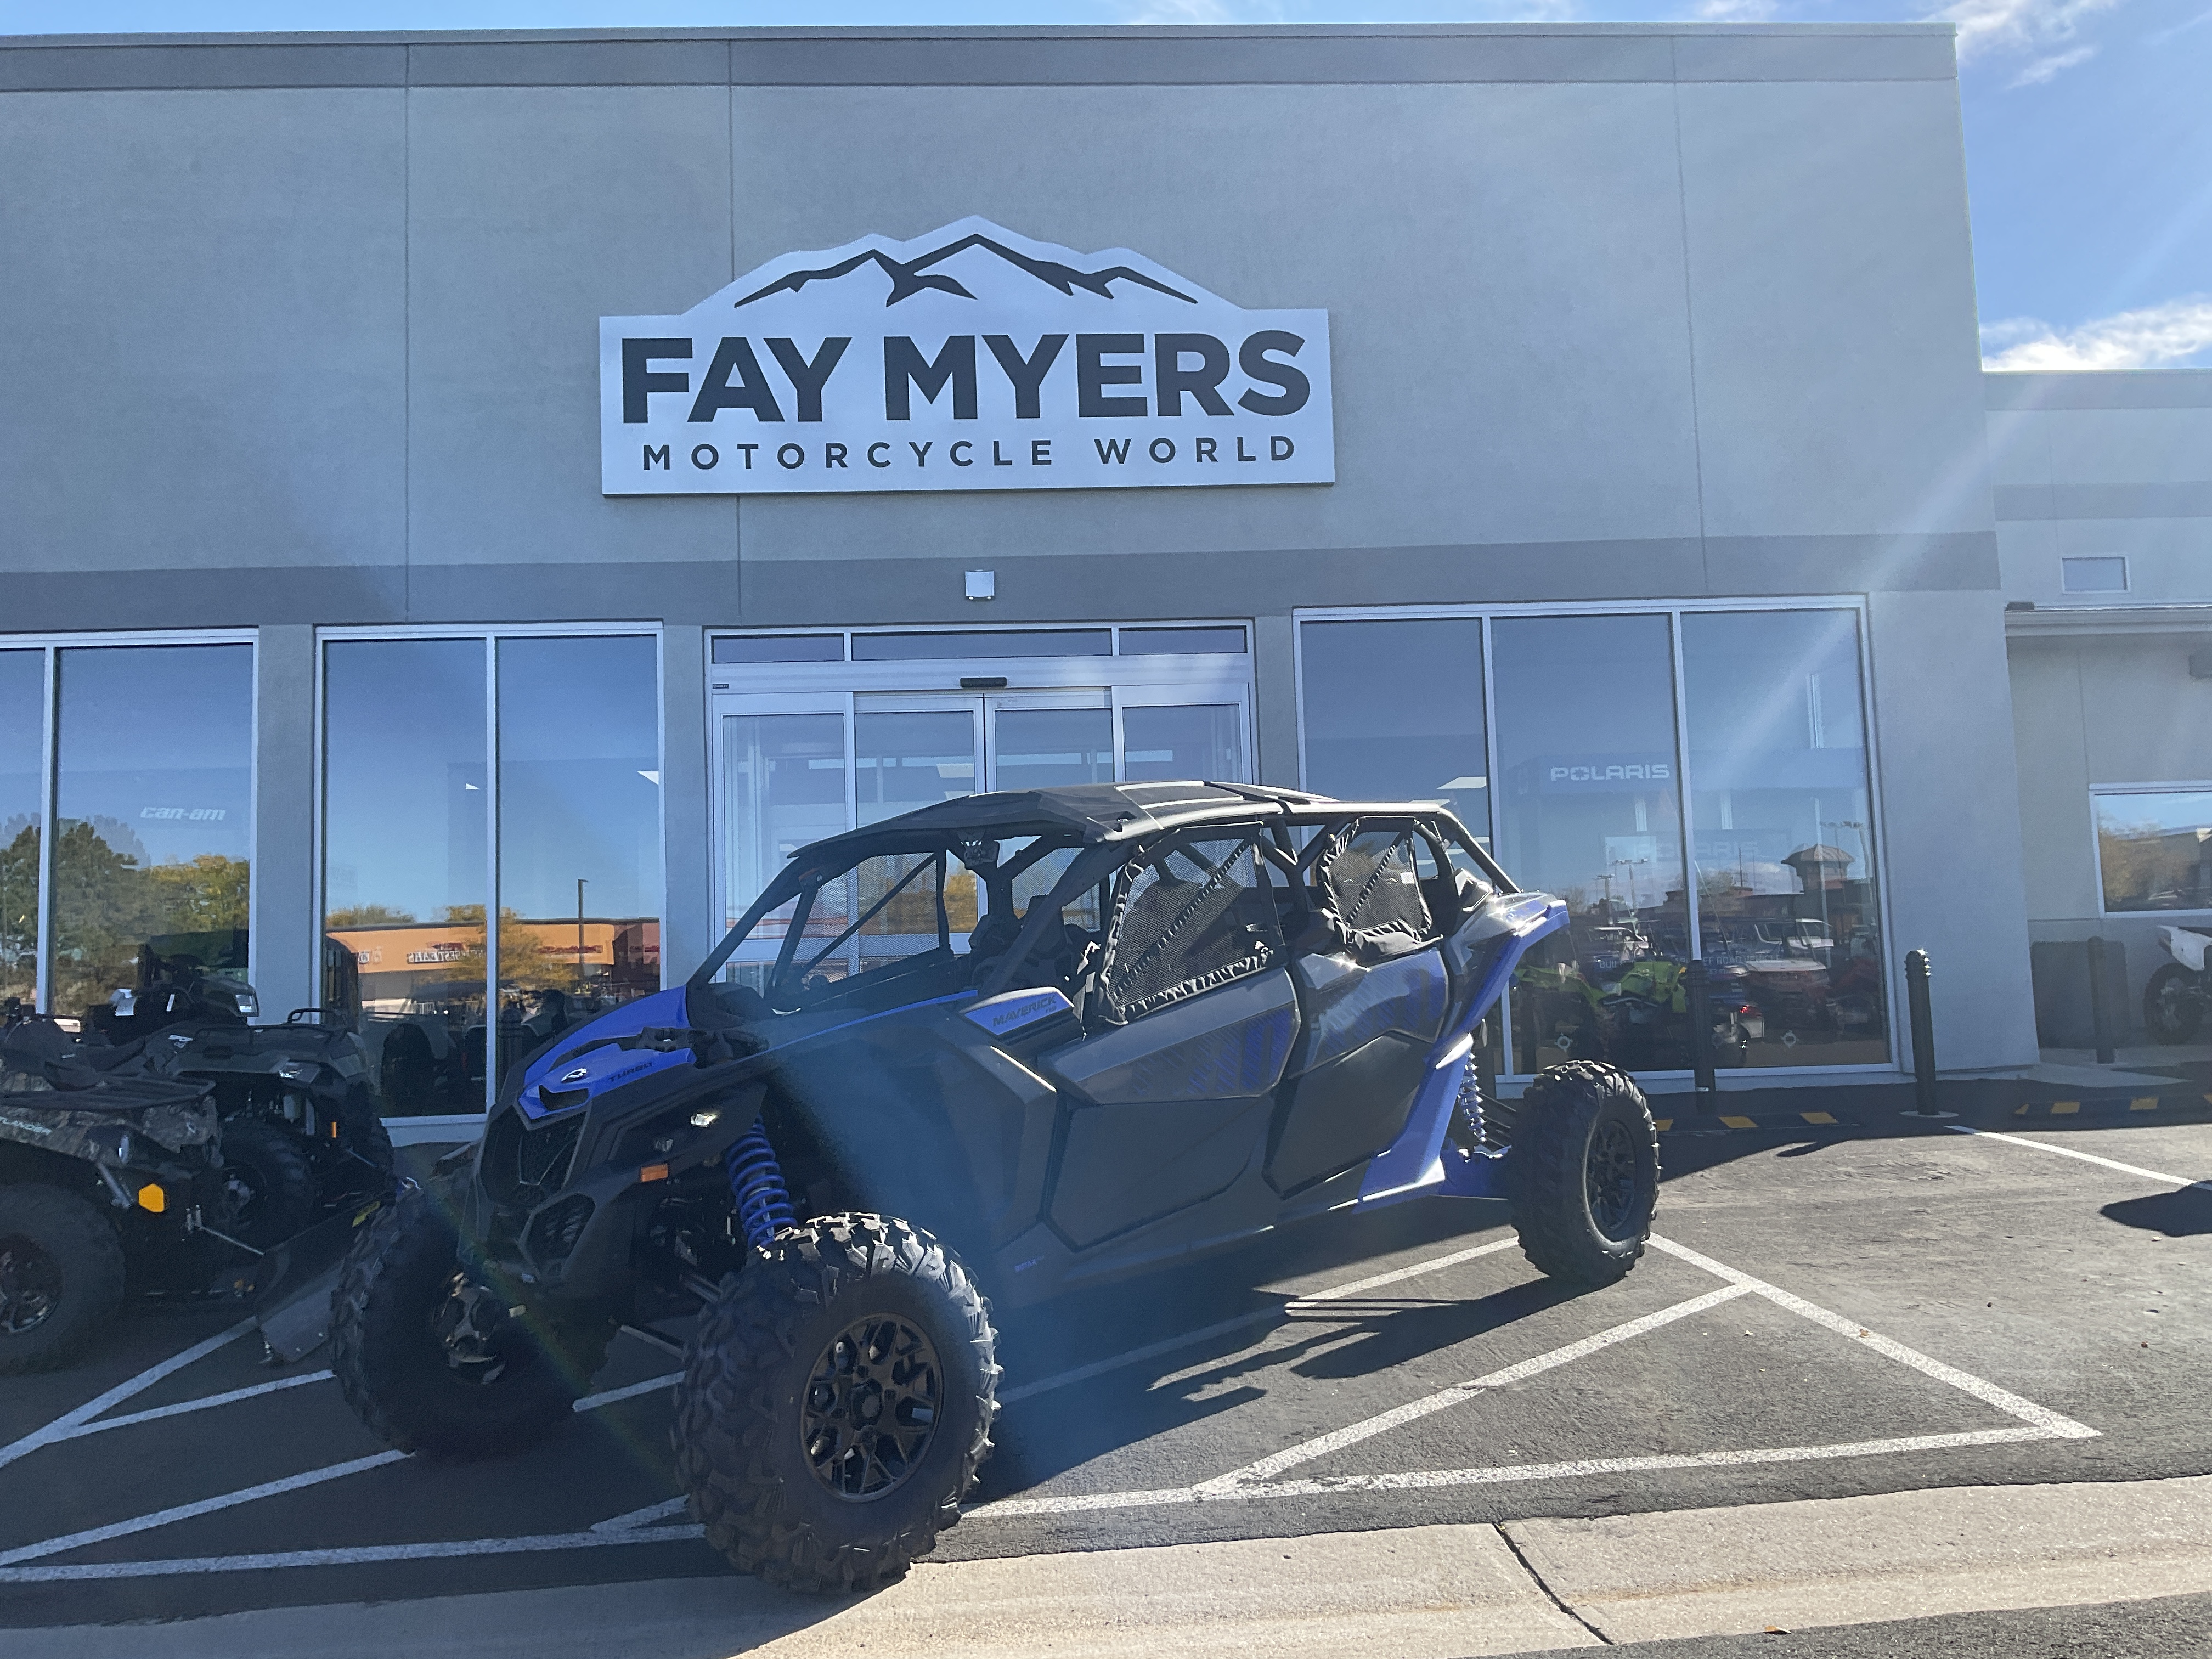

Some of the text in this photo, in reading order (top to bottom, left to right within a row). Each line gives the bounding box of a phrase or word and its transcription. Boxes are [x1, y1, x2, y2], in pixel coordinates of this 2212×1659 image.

[622, 330, 1311, 424] FAY MYERS
[642, 436, 1295, 471] MOTORCYCLE WORLD
[1550, 763, 1670, 782] POLARIS
[140, 806, 227, 821] can-am
[992, 994, 1057, 1027] MAVERICK
[608, 1061, 653, 1082] TURBO
